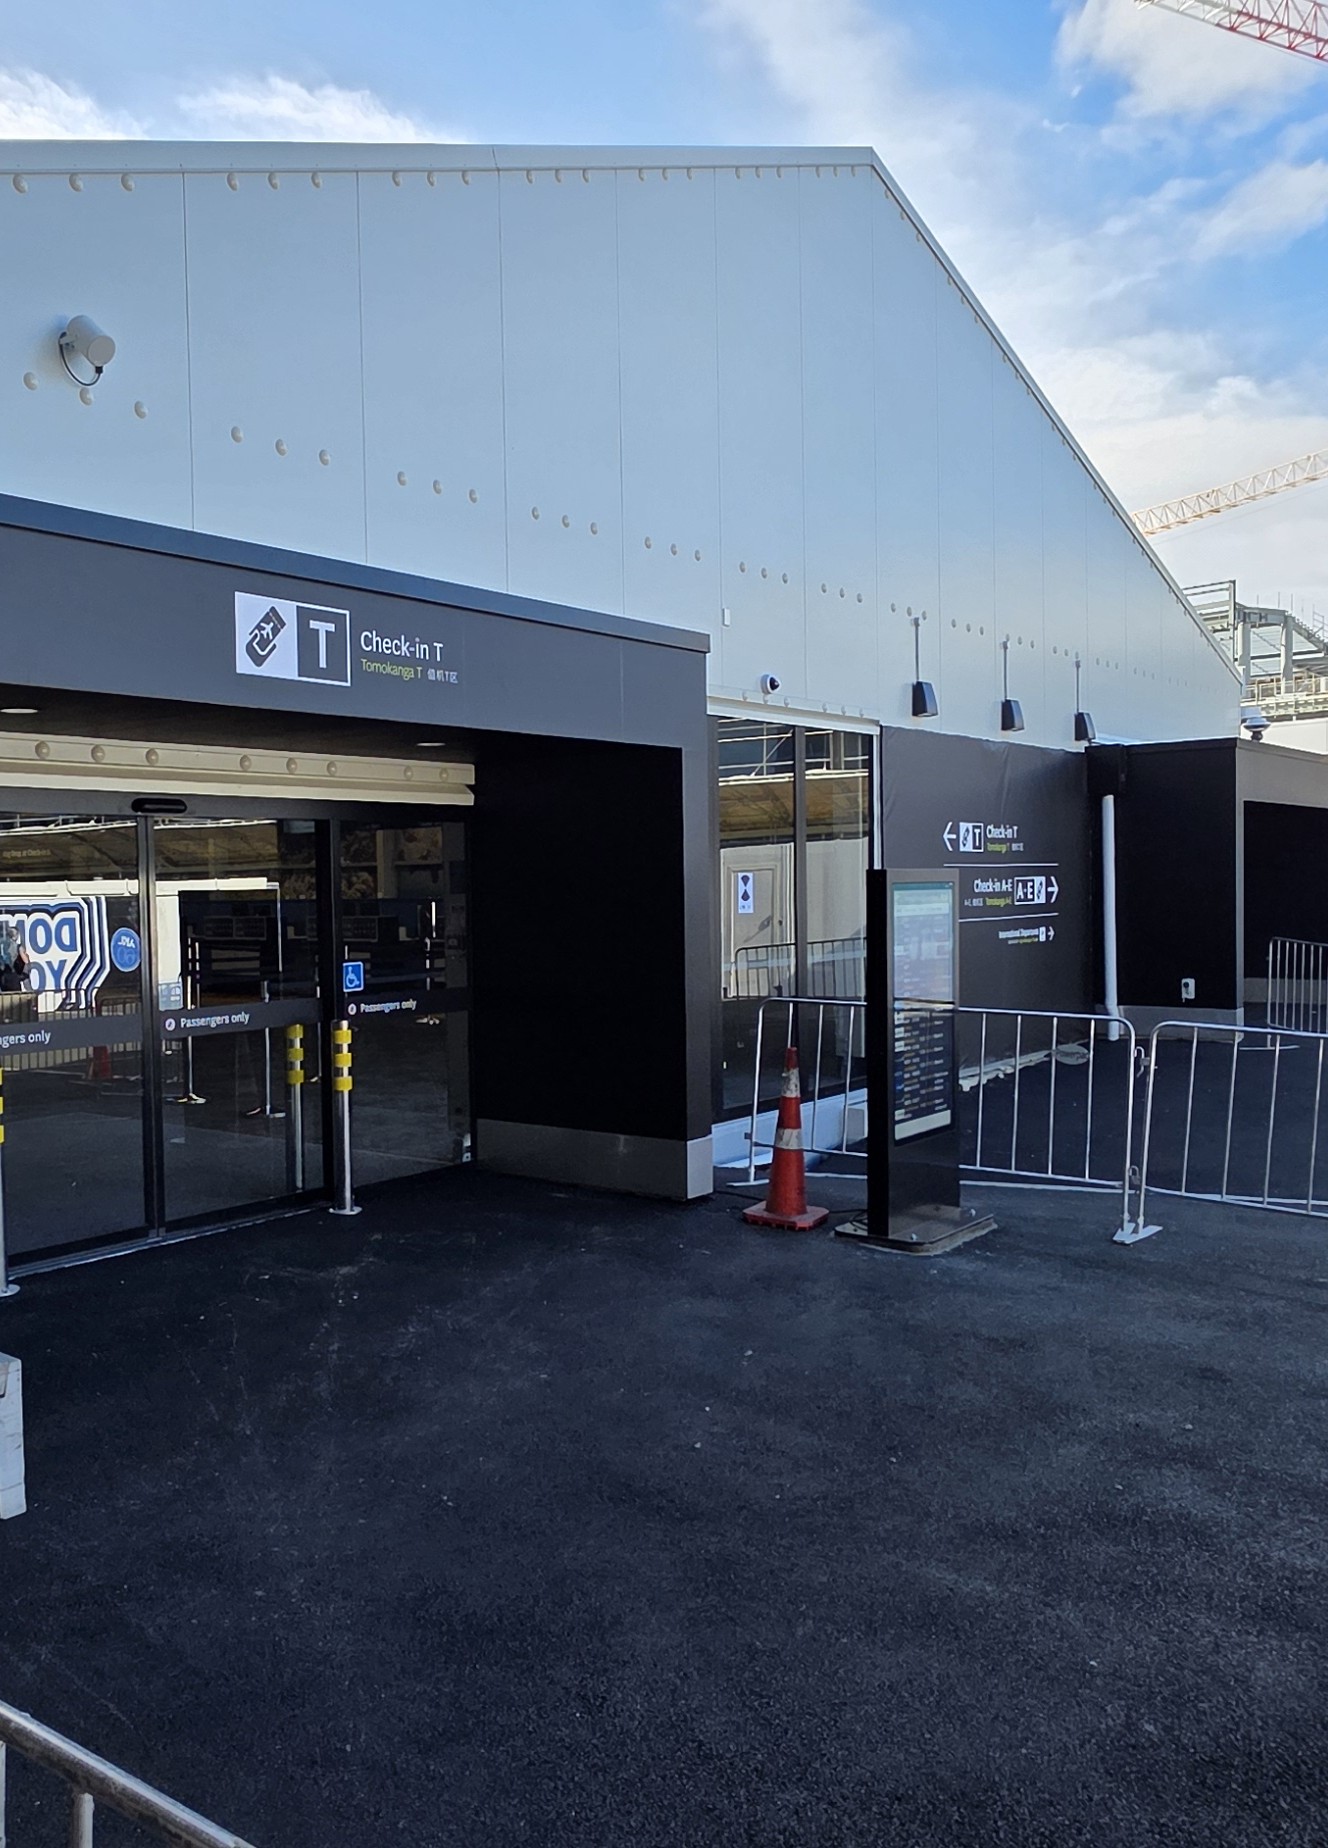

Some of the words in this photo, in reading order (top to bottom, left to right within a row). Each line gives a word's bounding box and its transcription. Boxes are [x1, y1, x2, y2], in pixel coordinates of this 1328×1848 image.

[309, 620, 336, 669] T
[360, 630, 430, 661] Check-in
[433, 643, 444, 662] T
[361, 658, 415, 681] Tomokanga
[416, 666, 423, 679] T
[974, 828, 981, 846] T
[986, 824, 1013, 839] Check-in
[1013, 825, 1018, 838] T
[973, 878, 1001, 893] Check-in
[360, 1002, 400, 1014] Passengers
[401, 999, 417, 1011] only
[180, 1014, 230, 1029] Passengers
[231, 1011, 250, 1025] only
[28, 1029, 52, 1045] only
